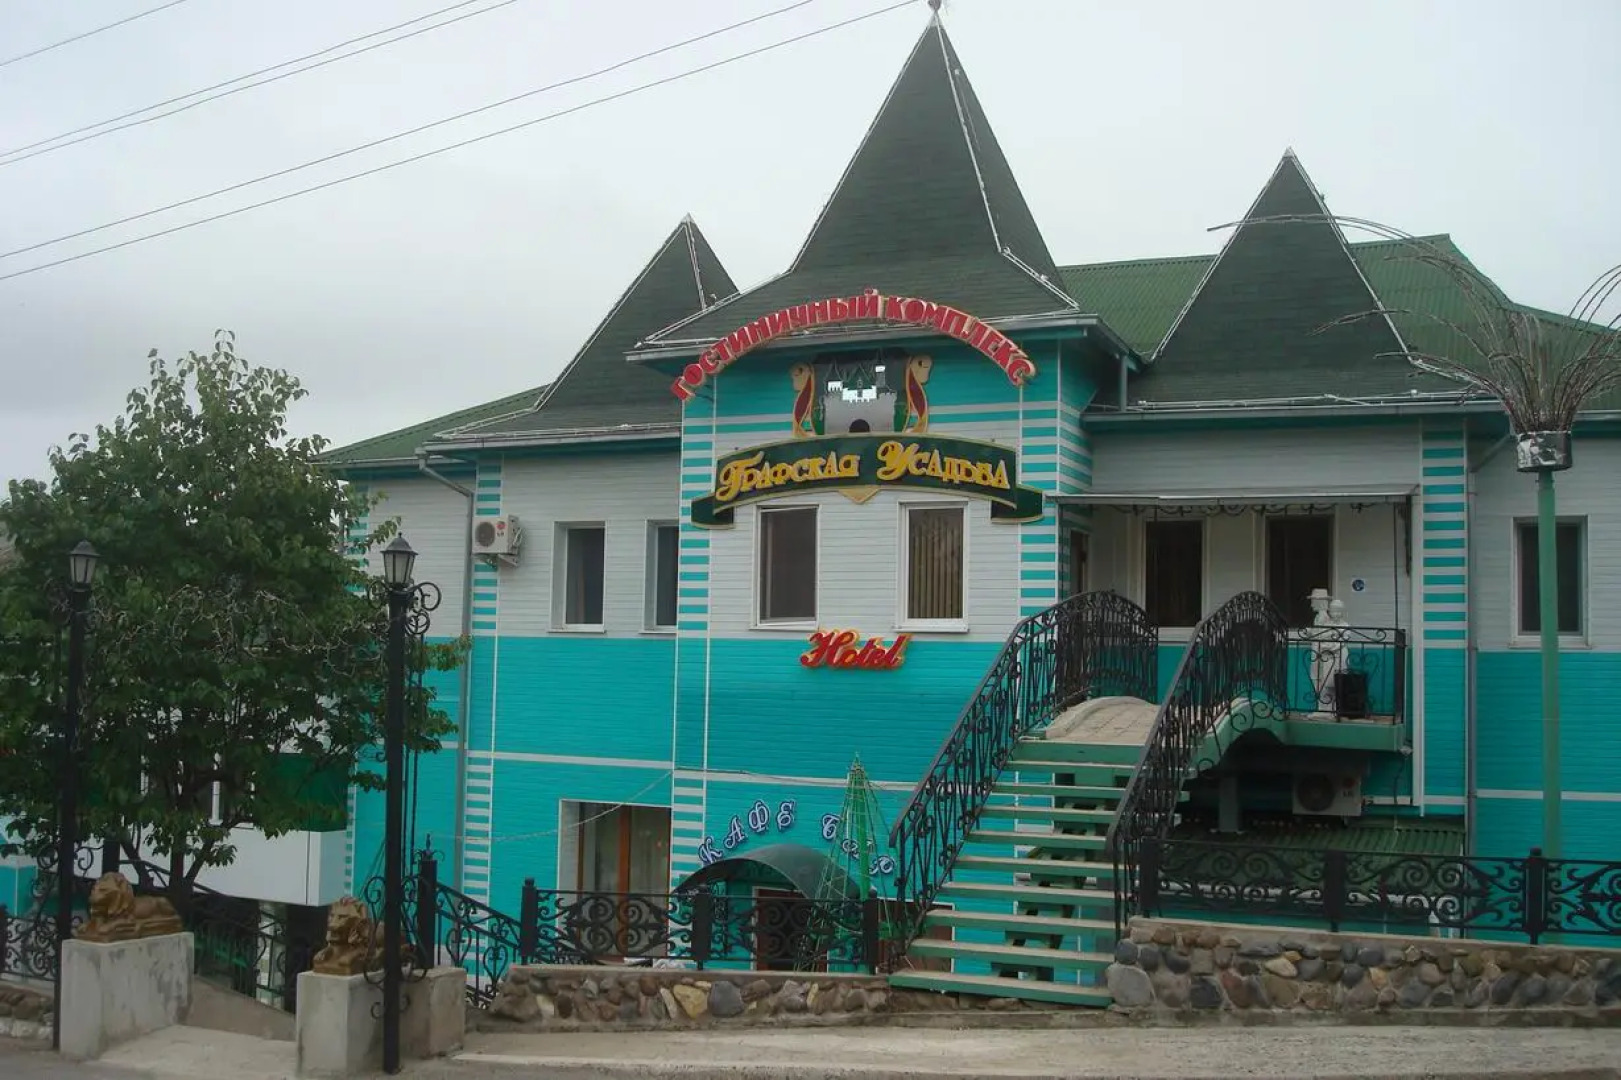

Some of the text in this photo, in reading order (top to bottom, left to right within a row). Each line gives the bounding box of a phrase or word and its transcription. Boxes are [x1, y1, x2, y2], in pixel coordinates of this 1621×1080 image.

[670, 288, 1036, 401] ГОСТИНИЧНЫЙ КОМПЛЕКС
[800, 629, 912, 669] Hotel
[698, 799, 797, 866] КАФЕ
